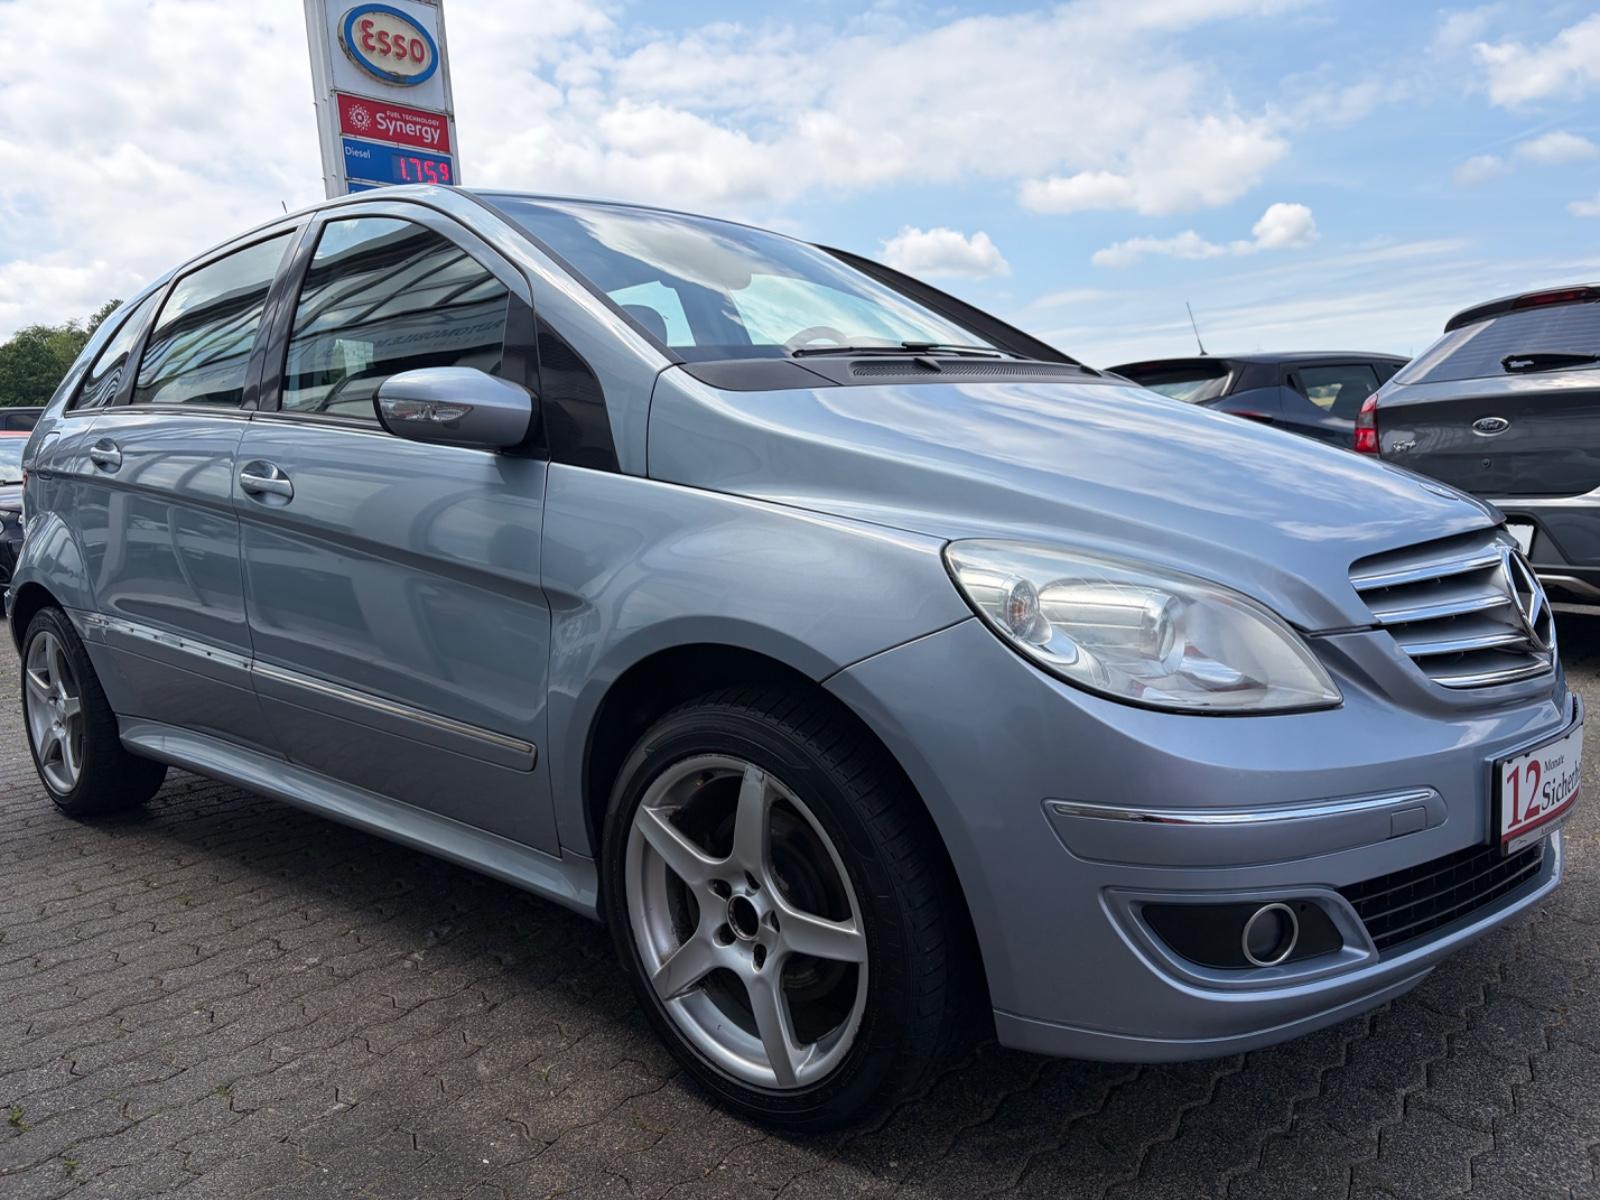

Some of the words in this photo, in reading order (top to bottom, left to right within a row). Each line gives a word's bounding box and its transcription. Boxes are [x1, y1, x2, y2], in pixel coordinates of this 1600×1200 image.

[376, 113, 440, 144] Synergy
[386, 110, 401, 119] FUEL
[402, 113, 439, 127] TECHNOLOGY
[345, 146, 371, 159] Diesel
[1507, 760, 1542, 829] 12
